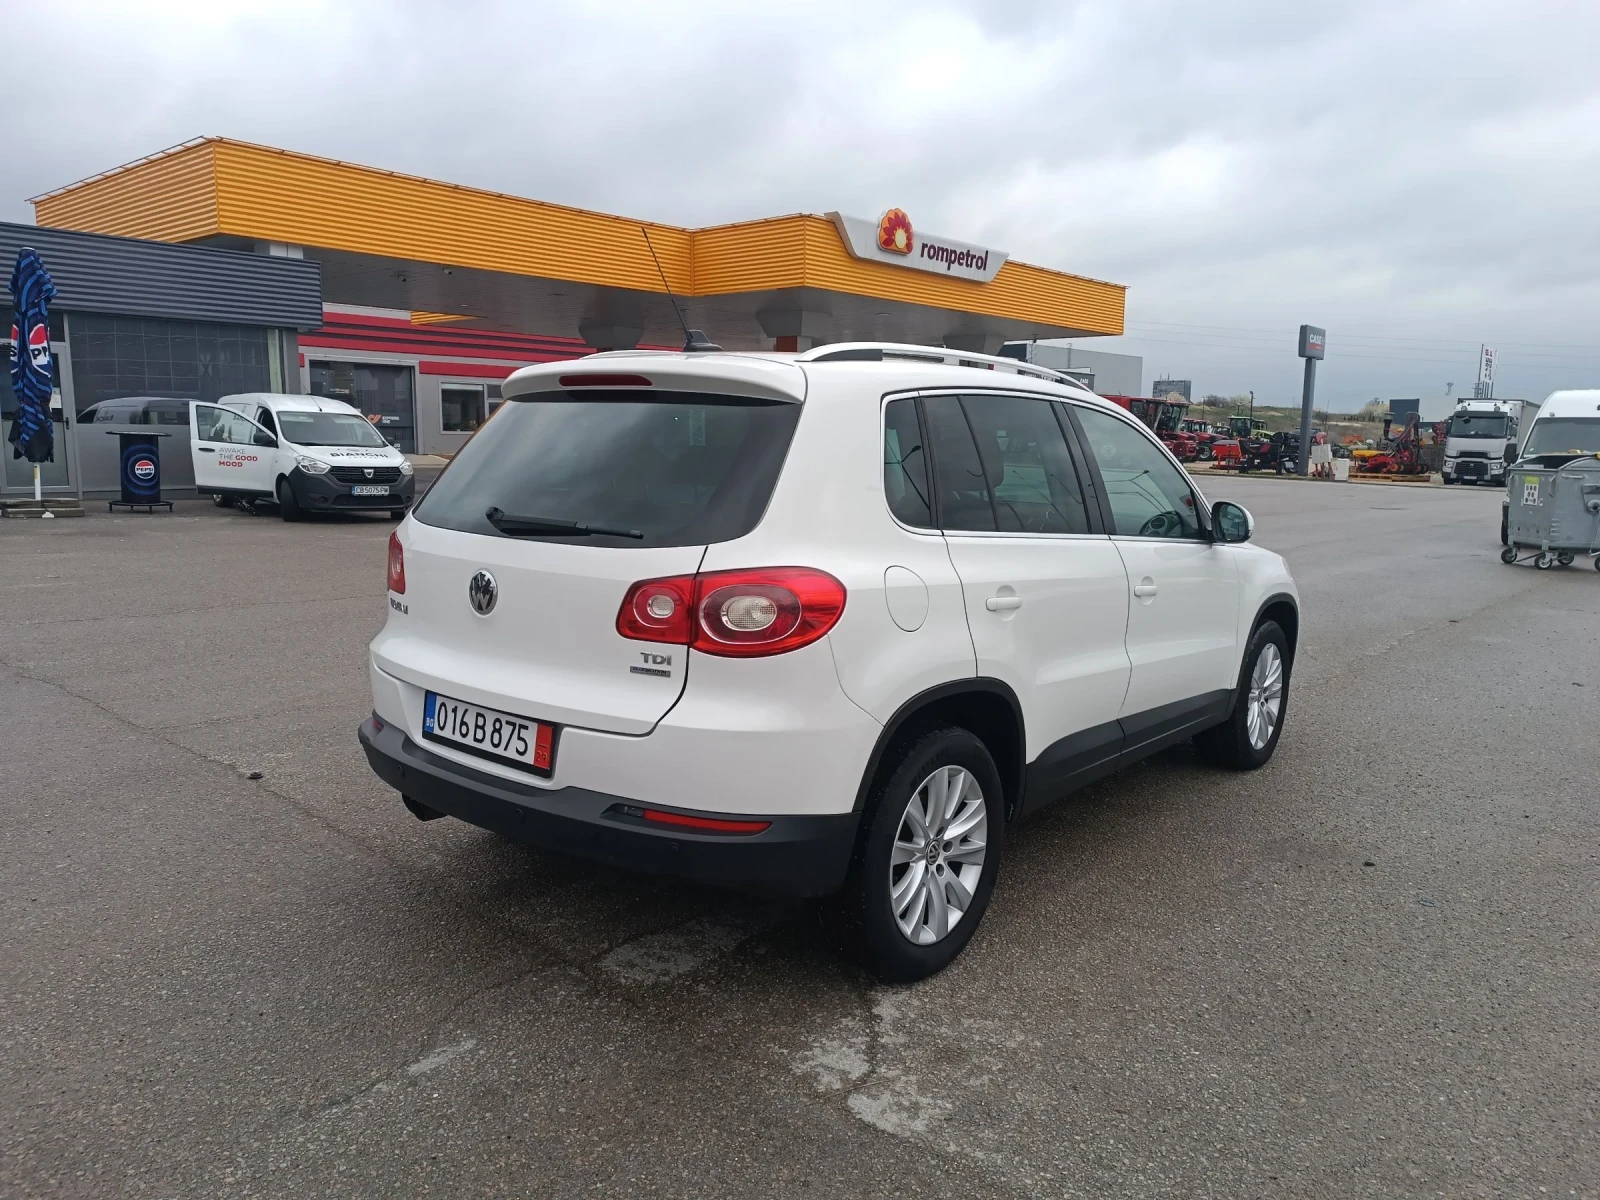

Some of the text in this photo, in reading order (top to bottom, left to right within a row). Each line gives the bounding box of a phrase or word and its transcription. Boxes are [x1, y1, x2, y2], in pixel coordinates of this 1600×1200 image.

[920, 242, 989, 272] rompetrol
[218, 447, 247, 455] AWAKE
[219, 453, 234, 461] THE
[640, 651, 672, 666] TDI
[425, 716, 435, 728] BG
[537, 749, 548, 763] 29
